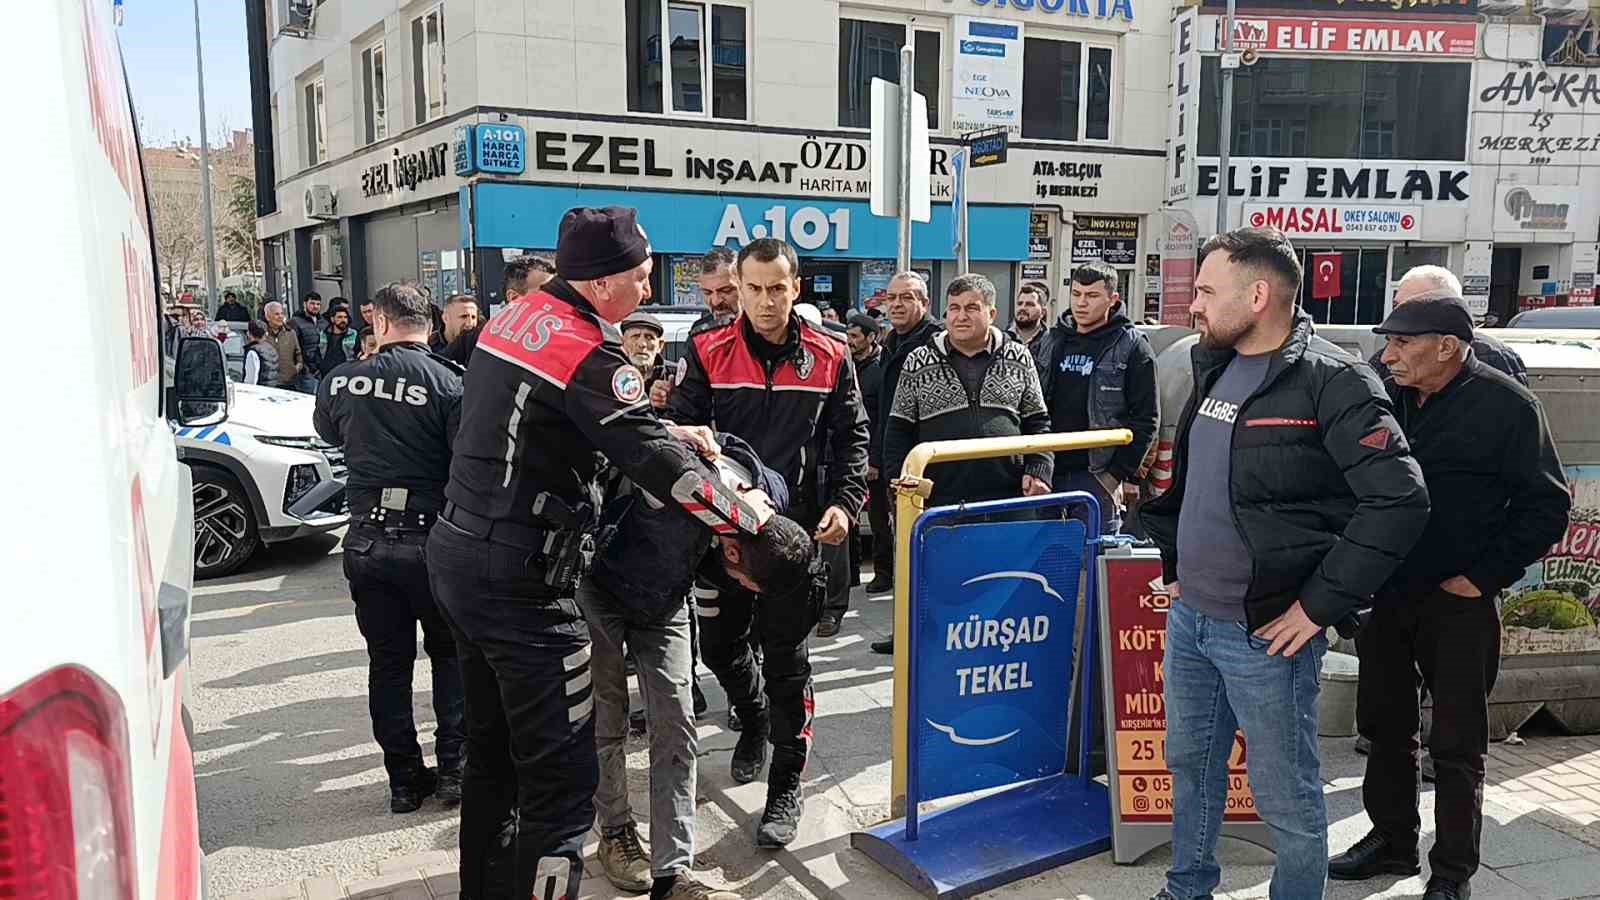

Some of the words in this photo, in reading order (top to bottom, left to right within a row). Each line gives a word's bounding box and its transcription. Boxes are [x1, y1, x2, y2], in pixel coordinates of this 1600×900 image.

[1277, 21, 1337, 49] ELİF
[1347, 26, 1447, 52] EMLAK
[965, 86, 1010, 98] NEOVA
[1529, 108, 1553, 131] İŞ
[483, 142, 520, 153] HARCA
[1476, 133, 1600, 153] MERKEZİ
[483, 151, 520, 161] HARCA
[536, 131, 672, 177] EZEL
[686, 149, 798, 184] İNŞAAT
[1033, 161, 1102, 181] ATA-SELÇUK
[1196, 164, 1290, 197] ELİF
[1305, 166, 1470, 200] EMLAK
[800, 177, 852, 193] HARİTA
[1036, 181, 1047, 198] İŞ
[1050, 184, 1098, 197] MERKEZİ
[1267, 206, 1343, 232] MASAL
[1344, 210, 1366, 222] OKEY
[1367, 211, 1401, 225] SALONU
[490, 302, 562, 351] OLİS
[330, 376, 428, 406] POLİS
[946, 615, 1049, 652] KÜRŞAD
[1119, 626, 1166, 651] KÖFT
[956, 662, 1034, 697] TEKEL
[1131, 740, 1155, 761] 25
